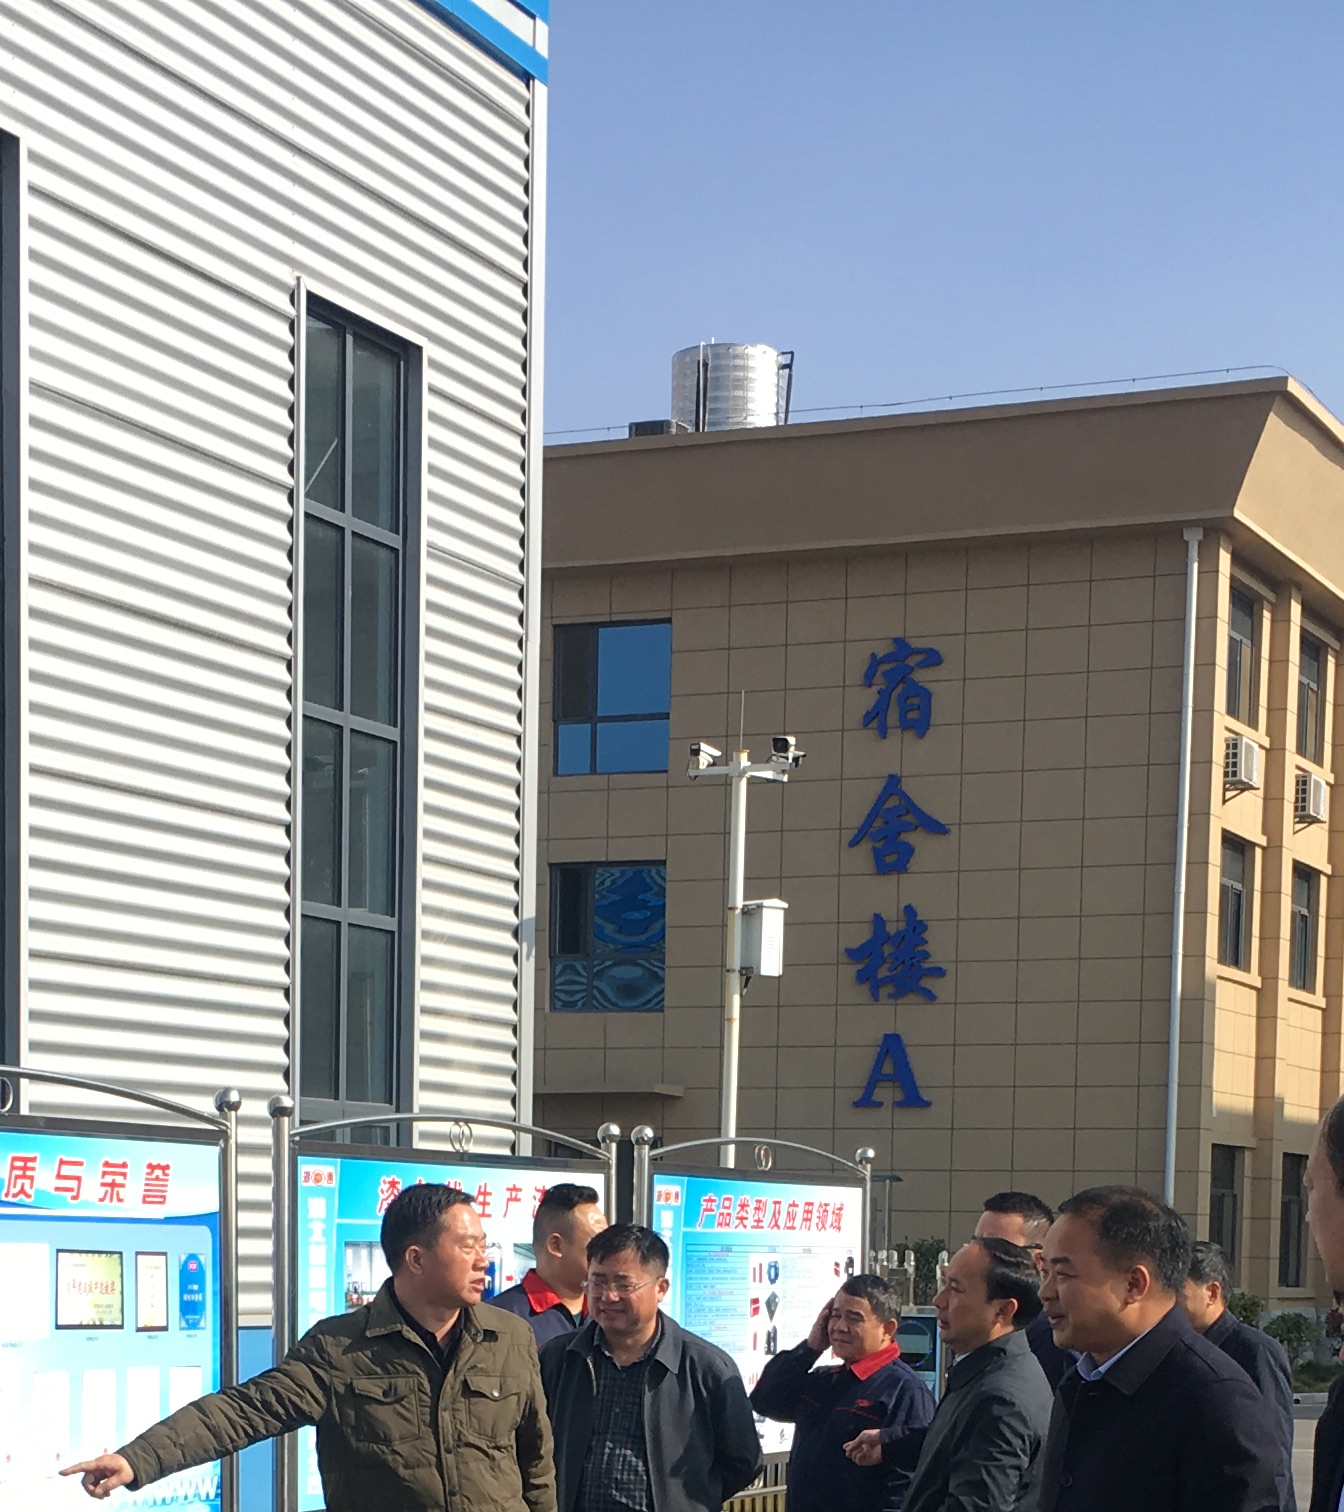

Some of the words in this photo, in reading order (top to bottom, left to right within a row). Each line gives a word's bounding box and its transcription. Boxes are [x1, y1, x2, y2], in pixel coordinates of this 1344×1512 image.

[845, 636, 950, 1110] 宿舍楼A
[698, 1195, 846, 1234] 产品类型及应用领域
